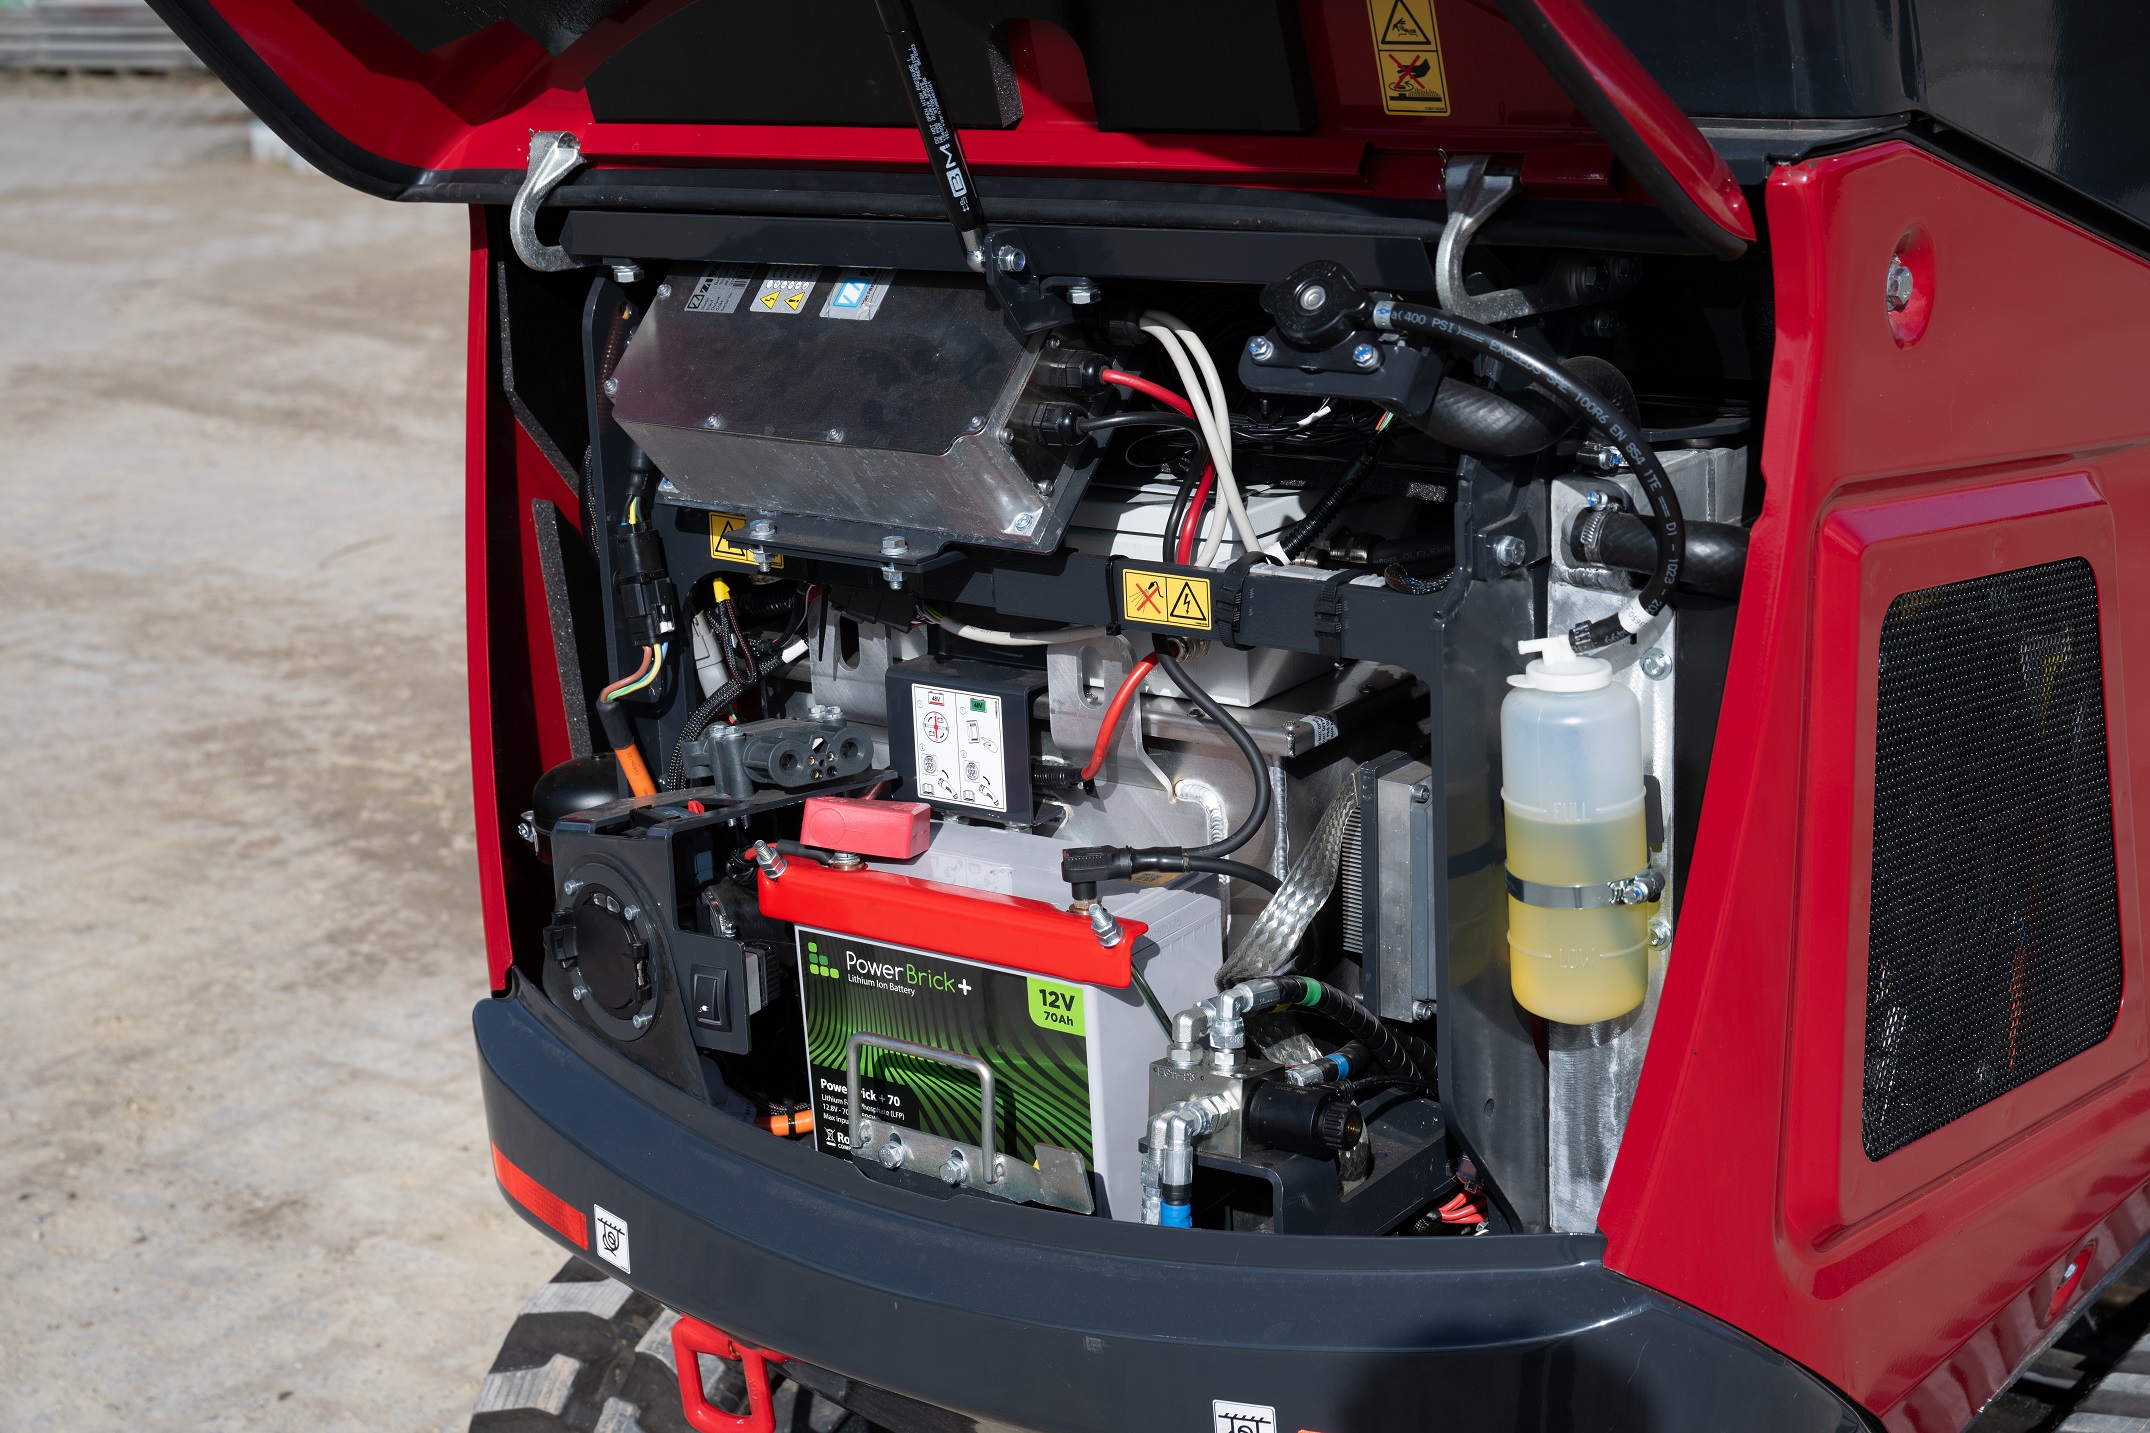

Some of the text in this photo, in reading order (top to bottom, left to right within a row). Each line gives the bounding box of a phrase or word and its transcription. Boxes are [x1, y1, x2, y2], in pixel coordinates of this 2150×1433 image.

[1390, 309, 1427, 327] a(400
[1574, 391, 1609, 426] 100R6
[1608, 418, 1629, 443] EN
[1625, 441, 1648, 467] 854
[1644, 469, 1663, 494] 1TE
[1665, 521, 1679, 537] D1
[1553, 801, 1592, 822] FULL
[1559, 947, 1596, 969] LOW
[848, 974, 916, 997] Lithium Ion Battery
[1039, 989, 1075, 1012] 12V
[1043, 1011, 1074, 1026] 70Ah
[820, 1078, 877, 1102] Poweick
[887, 1094, 901, 1107] 70
[821, 1093, 844, 1105] Lithium
[890, 1110, 905, 1120] (LFP)
[822, 1103, 838, 1113] 12.8V
[823, 1112, 849, 1125] Max inpu
[837, 1131, 850, 1145] Ro
